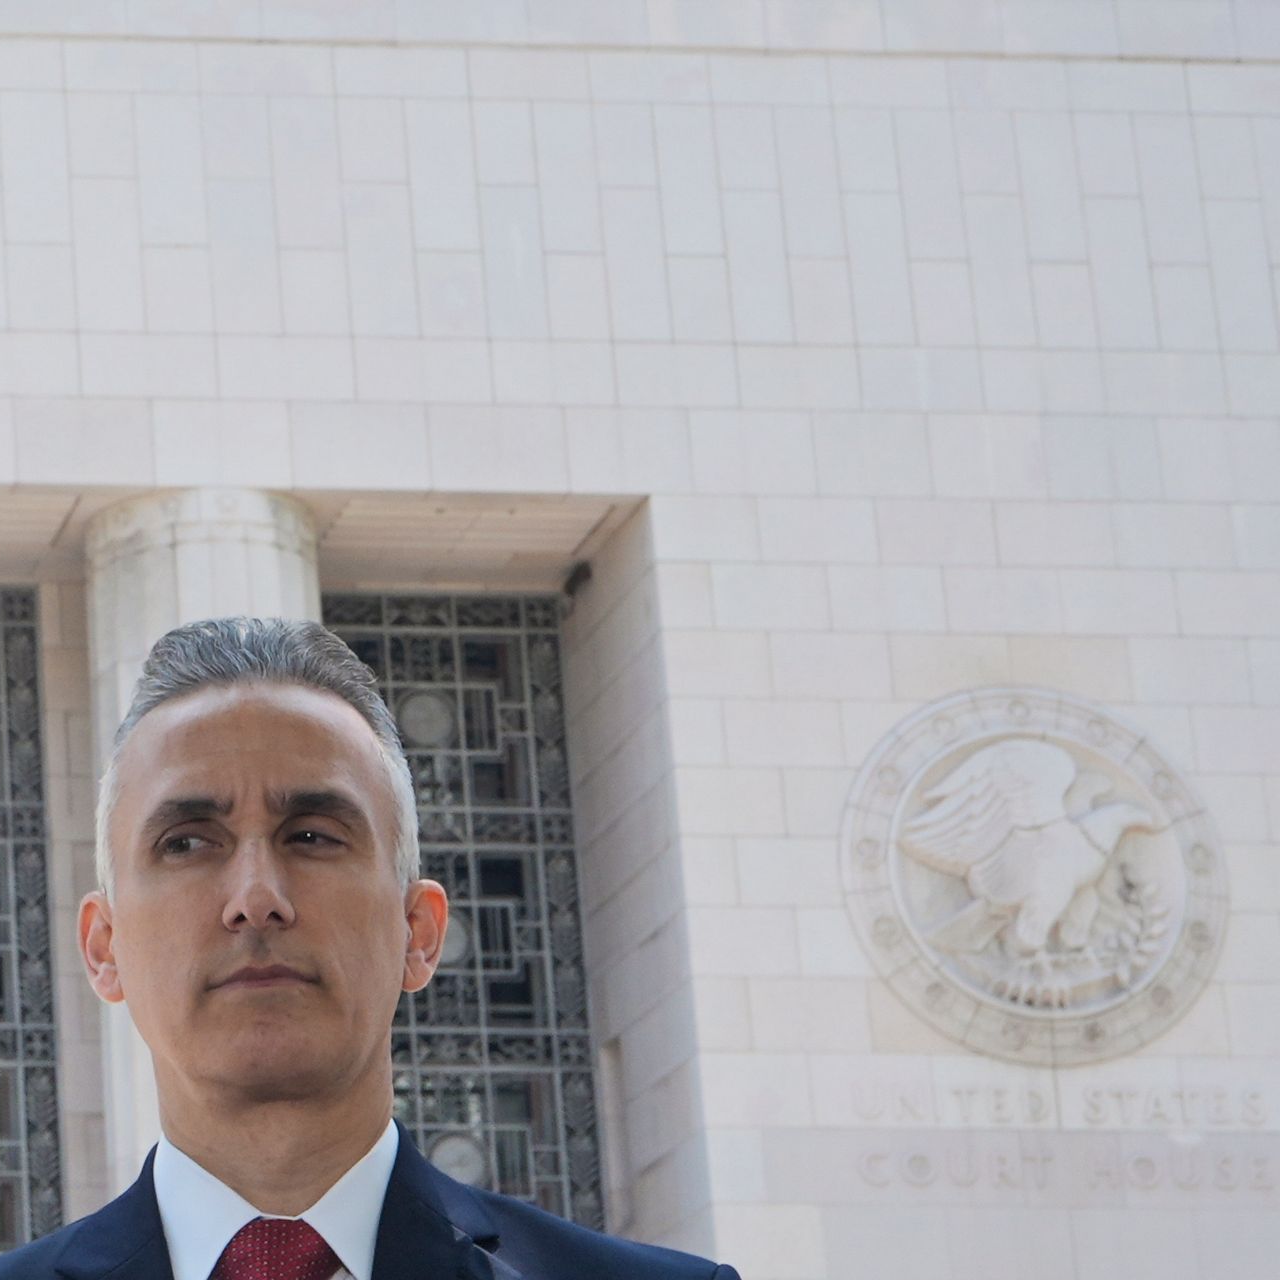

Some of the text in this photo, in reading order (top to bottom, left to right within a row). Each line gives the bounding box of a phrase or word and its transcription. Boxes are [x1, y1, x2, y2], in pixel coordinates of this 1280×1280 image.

[849, 1086, 1268, 1127] UNITED STATES
[856, 1151, 1276, 1193] COURT HOUSE
